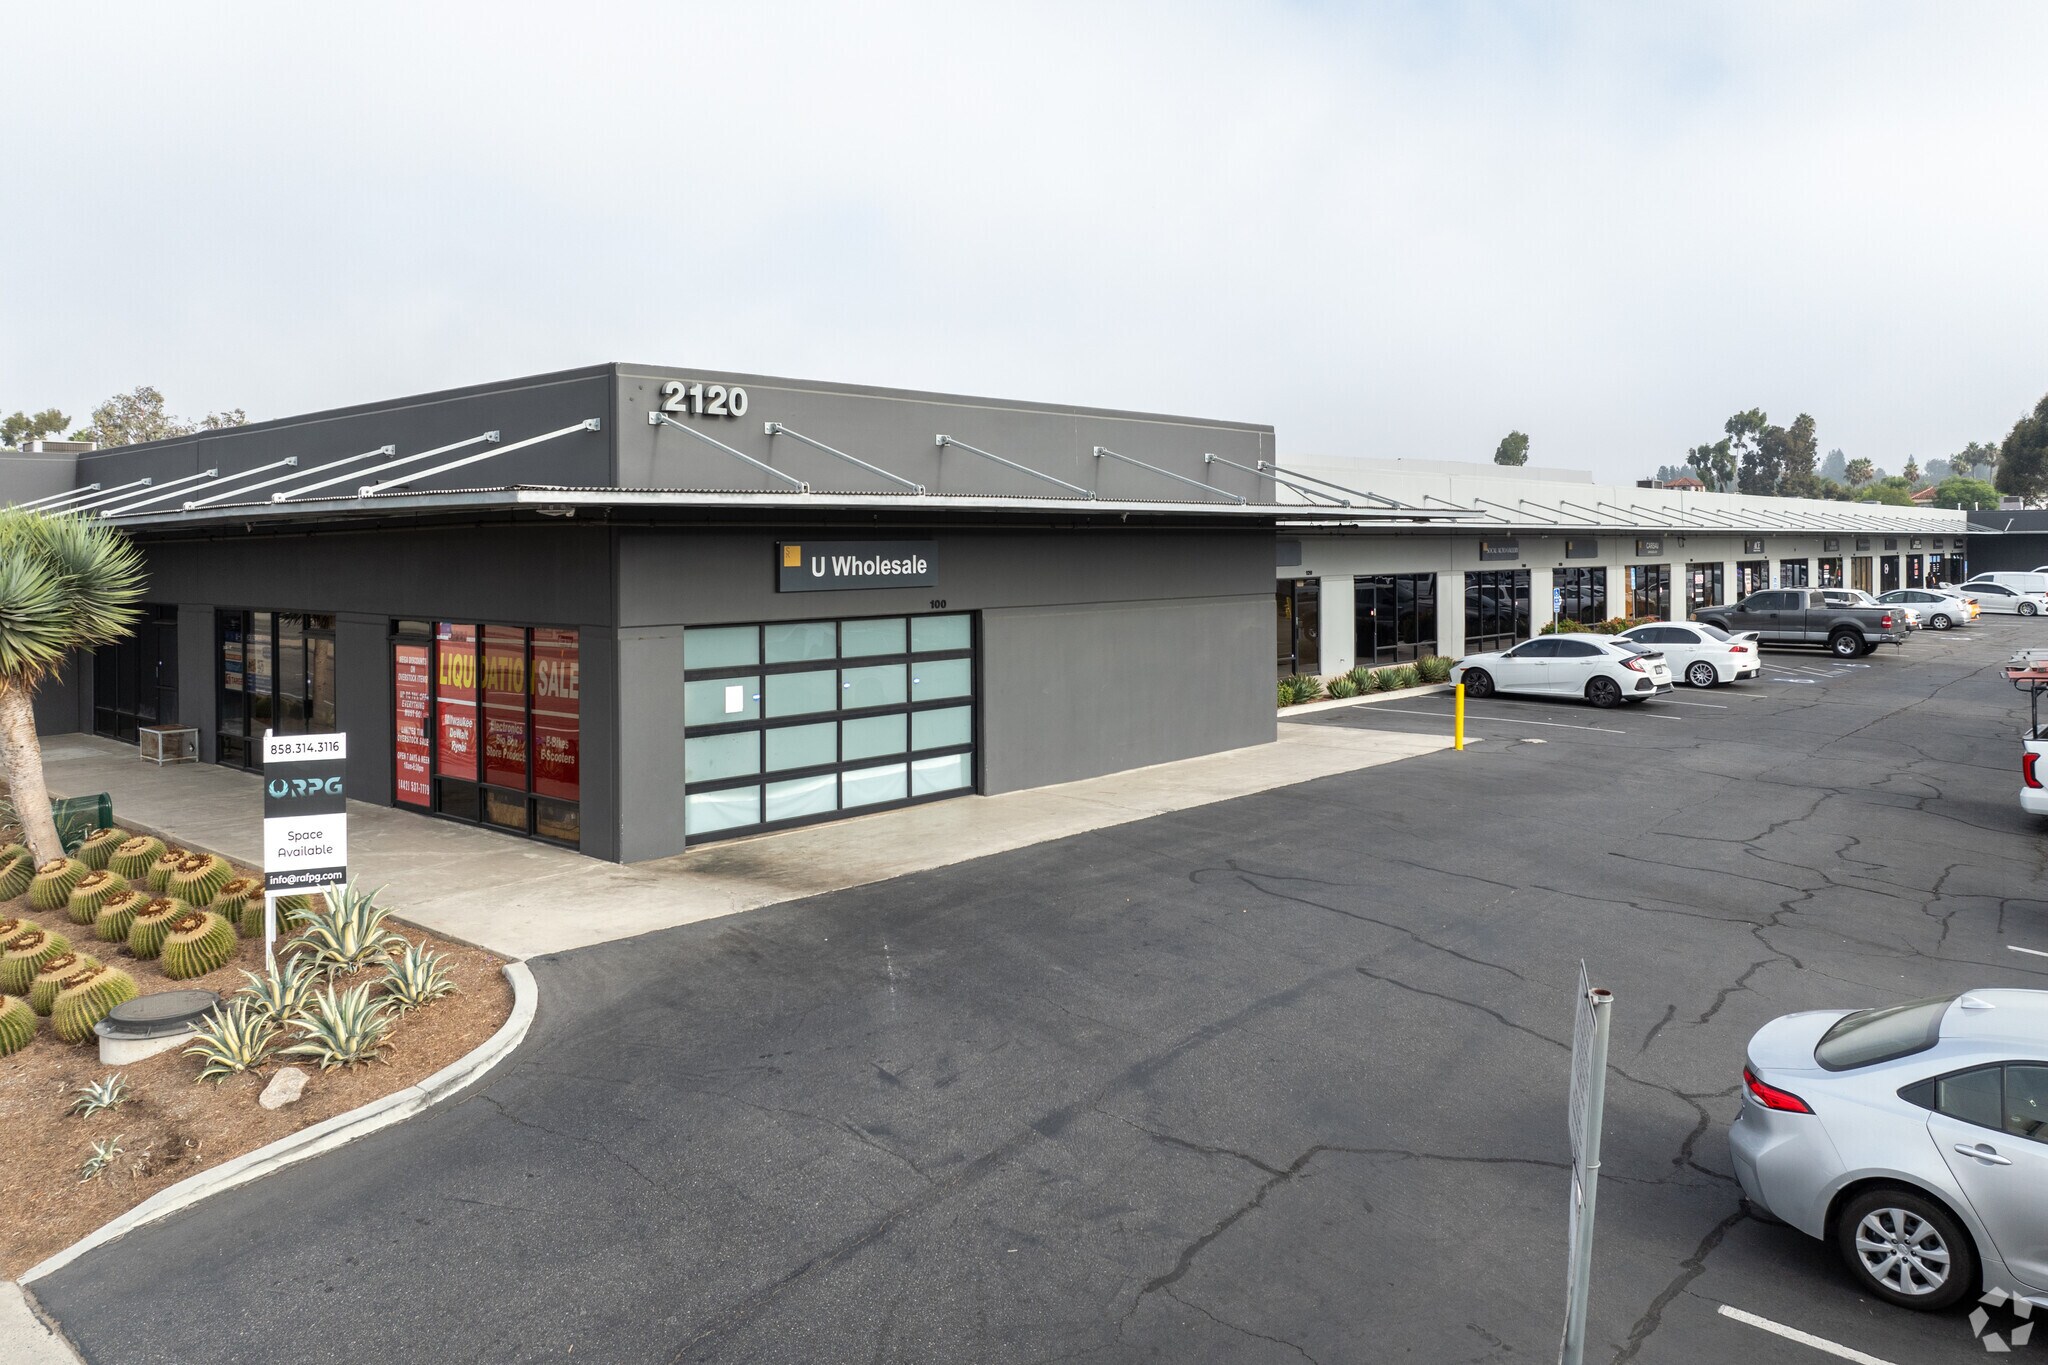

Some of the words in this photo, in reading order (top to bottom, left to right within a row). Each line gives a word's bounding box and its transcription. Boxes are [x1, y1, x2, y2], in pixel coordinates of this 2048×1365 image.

[661, 381, 749, 418] 2120
[811, 556, 826, 578] U
[831, 554, 927, 577] Wholesale
[929, 599, 947, 609] 100
[537, 660, 579, 699] SALE
[449, 728, 469, 740] DeWalt
[270, 741, 340, 755] 858.314.3116
[541, 749, 575, 765] E-Scooters
[291, 776, 343, 798] RPG
[287, 830, 323, 843] Space
[278, 844, 333, 858] Available
[269, 871, 343, 885] info@rafpg.com
